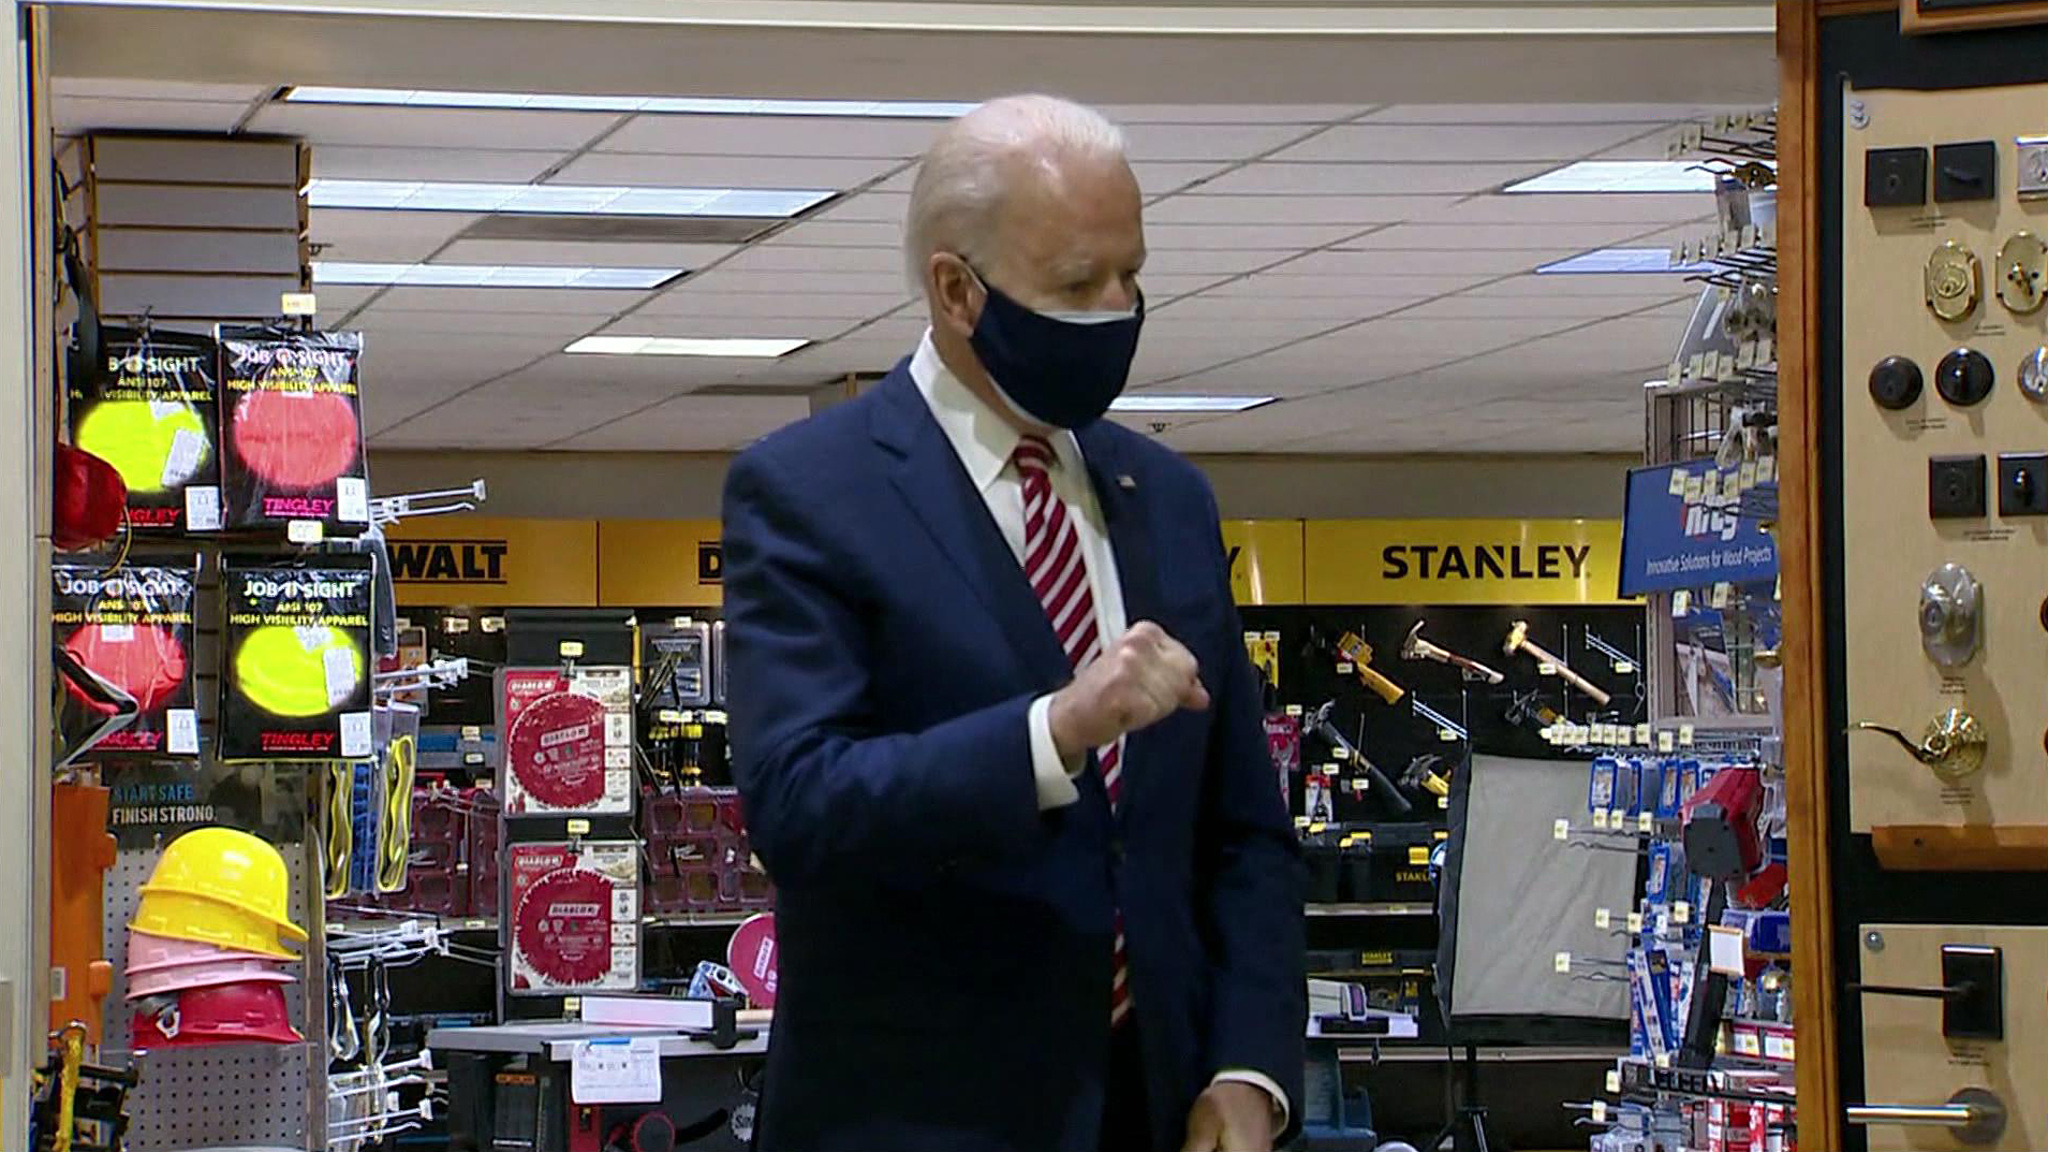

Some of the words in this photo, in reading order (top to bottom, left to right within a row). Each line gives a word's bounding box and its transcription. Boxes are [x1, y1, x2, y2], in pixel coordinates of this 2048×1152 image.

[147, 357, 201, 372] SIGHT
[263, 497, 336, 511] TINGLEY
[386, 545, 508, 579] WALT
[1382, 545, 1591, 579] STANLEY
[1645, 556, 1680, 575] Innovative
[1680, 552, 1710, 572] Solutions
[1711, 549, 1722, 568] for
[1722, 547, 1742, 567] Wood
[1743, 545, 1772, 567] Projects
[60, 580, 100, 594] JOB
[243, 581, 279, 597] JOB
[303, 582, 358, 598] SIGHT
[230, 614, 260, 625] HIGH
[263, 614, 315, 626] VISIBILITY
[318, 615, 369, 627] APPAREL
[261, 732, 336, 746] TINGLEY
[159, 783, 195, 801] SAFE
[112, 806, 158, 825] FINISH
[1396, 871, 1432, 883] STANL
